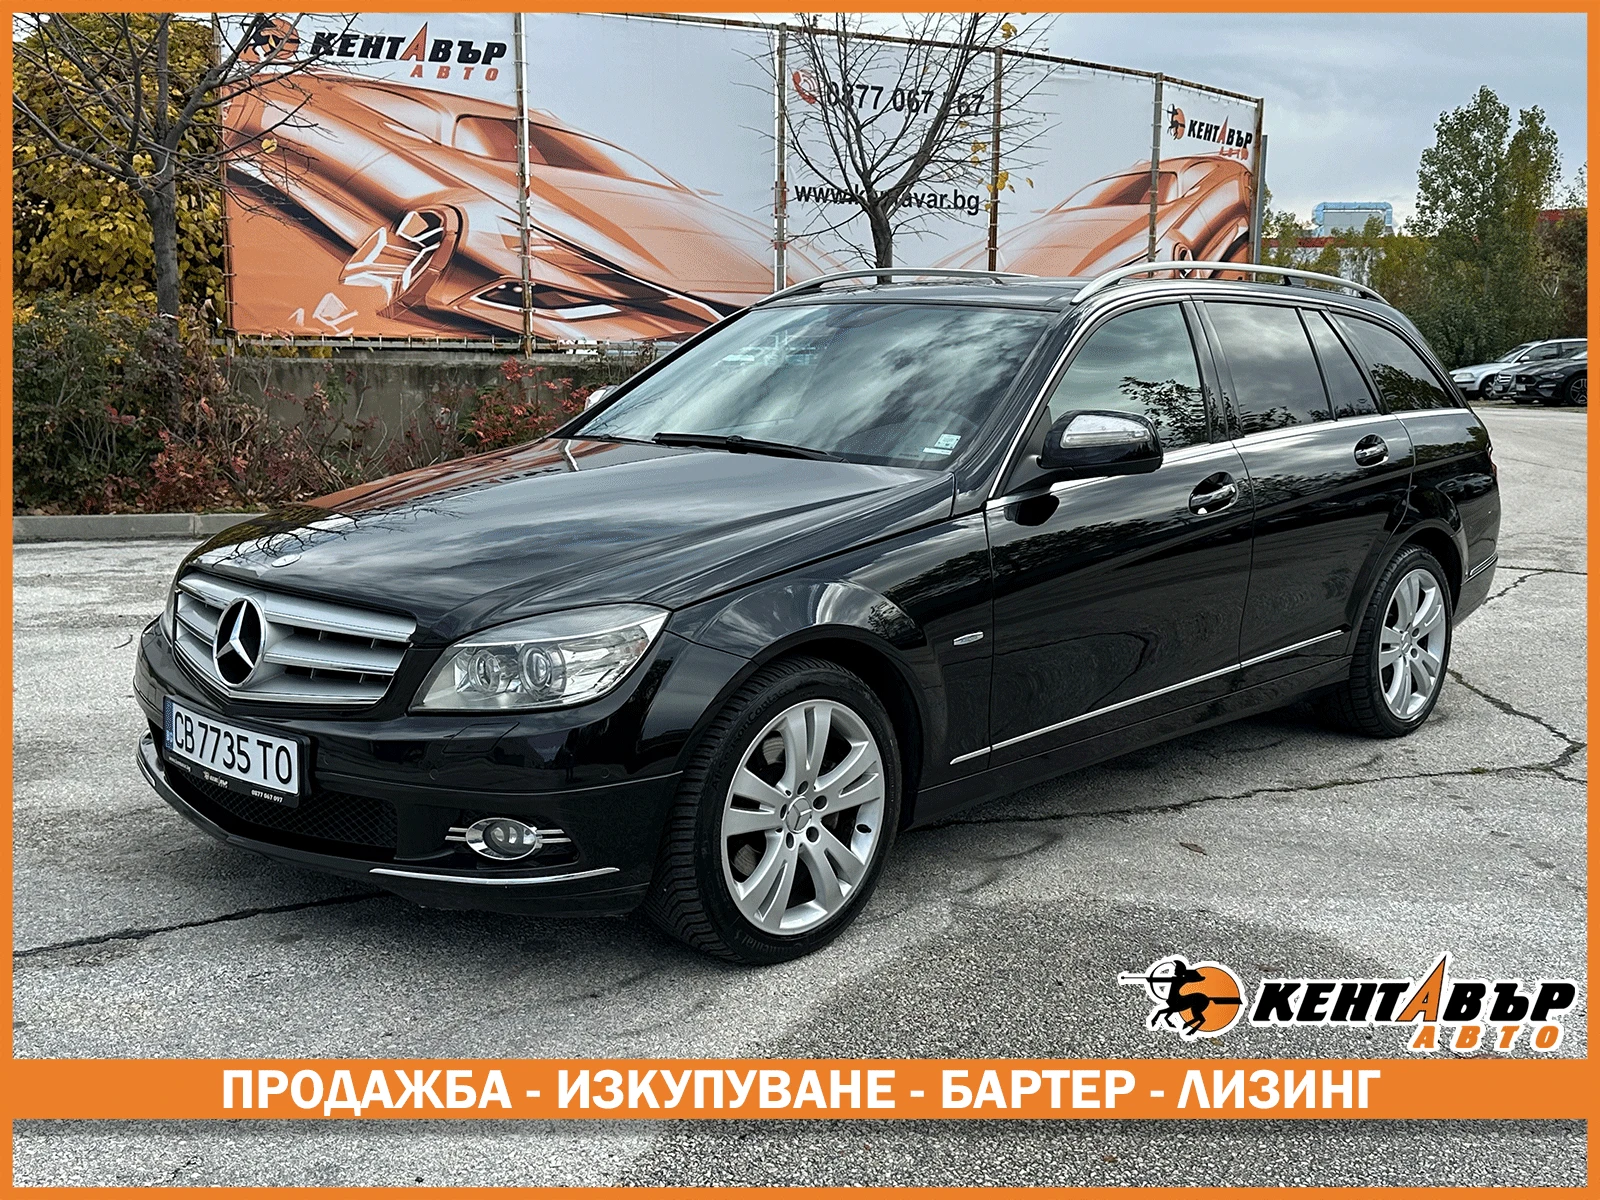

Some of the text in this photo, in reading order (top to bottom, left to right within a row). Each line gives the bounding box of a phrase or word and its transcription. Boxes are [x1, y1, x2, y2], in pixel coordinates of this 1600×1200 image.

[309, 22, 507, 65] КЕНТАВЪР
[410, 64, 499, 81] АВТО
[893, 88, 934, 114] 067
[1187, 115, 1253, 148] КЕНТАВЪР
